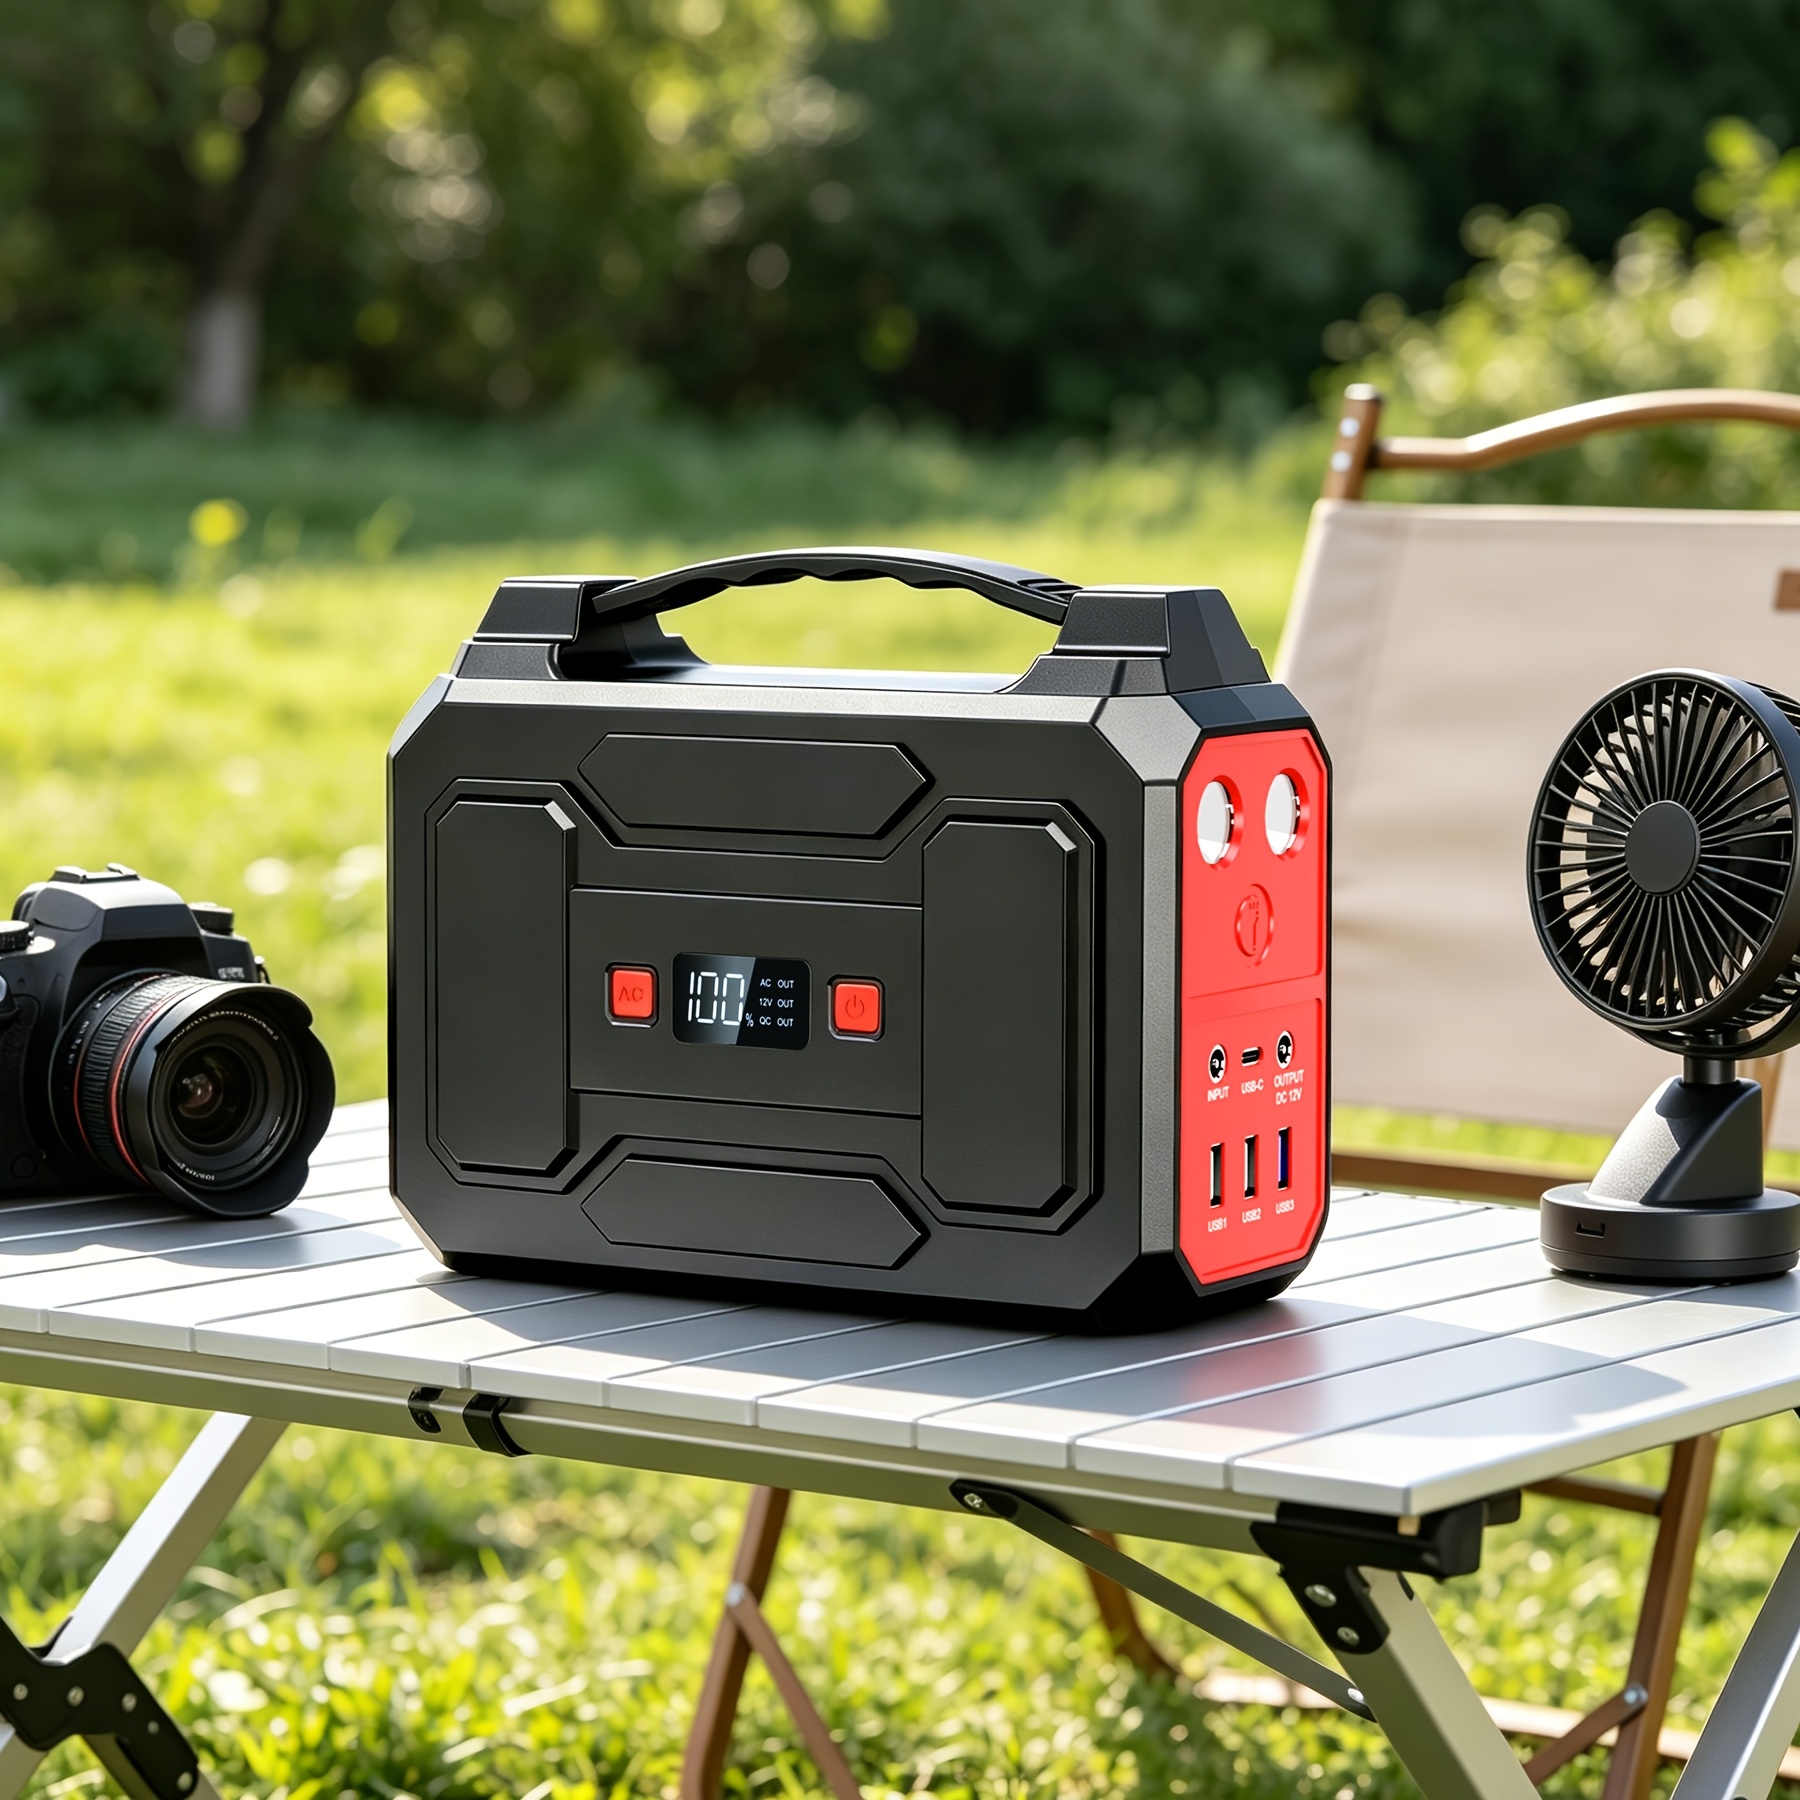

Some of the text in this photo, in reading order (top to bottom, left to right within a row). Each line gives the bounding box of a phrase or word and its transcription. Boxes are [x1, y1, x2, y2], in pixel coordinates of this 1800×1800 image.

[760, 979, 794, 989] AC OUT
[618, 986, 644, 1002] AC
[759, 998, 794, 1008] 12V OUT
[759, 1016, 794, 1027] QC OUT
[1241, 1078, 1264, 1094] USB-C
[1273, 1069, 1304, 1088] OUTPUT
[1207, 1086, 1229, 1102] INPUT
[1276, 1087, 1303, 1105] DC 12V
[1275, 1199, 1295, 1214] USB3
[1242, 1207, 1262, 1224] USB2
[1207, 1217, 1227, 1233] USB1
